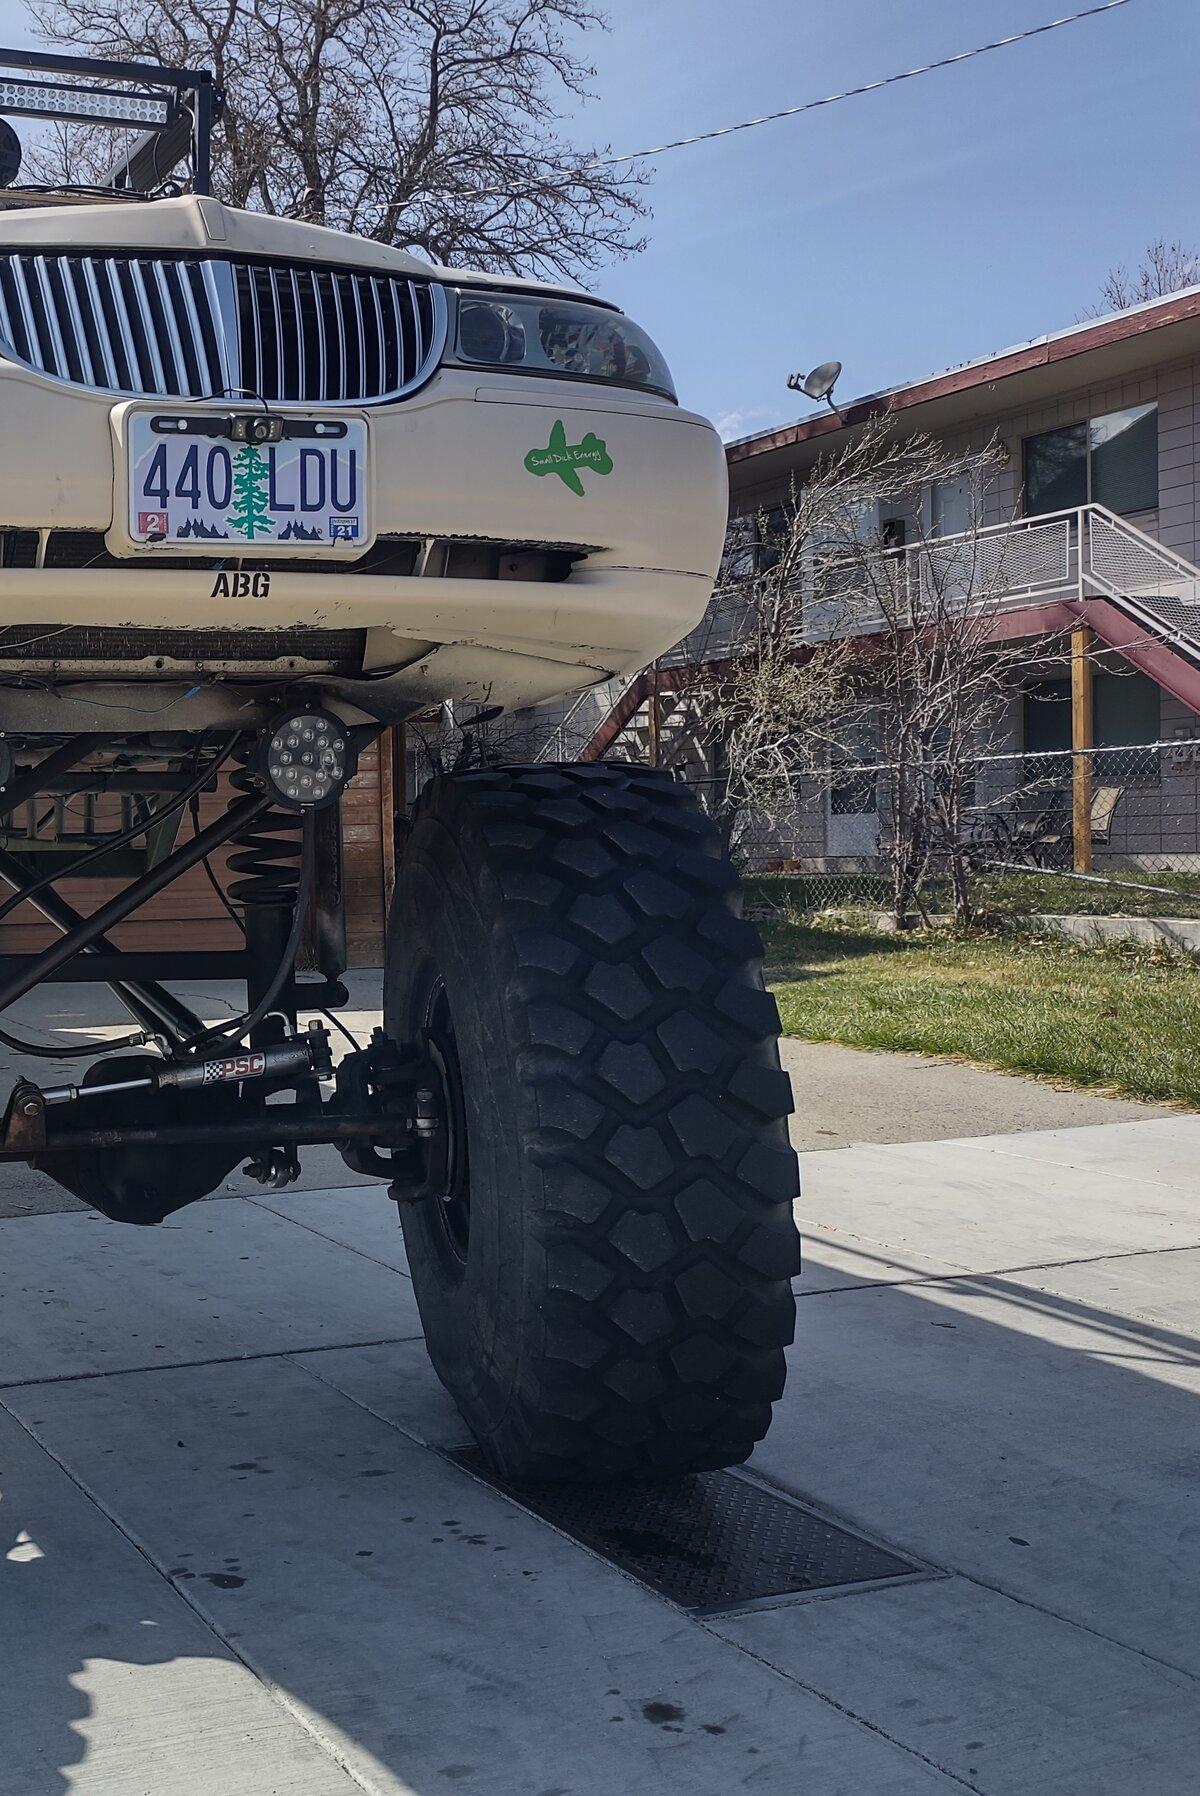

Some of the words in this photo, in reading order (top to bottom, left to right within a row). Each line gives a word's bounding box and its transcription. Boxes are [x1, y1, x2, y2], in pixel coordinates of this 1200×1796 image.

[553, 450, 573, 463] Dick
[143, 443, 233, 511] 440
[269, 446, 357, 513] LDU
[146, 513, 160, 532] 2
[337, 525, 352, 537] 21
[210, 572, 271, 599] ABG
[220, 1054, 263, 1078] PSC
